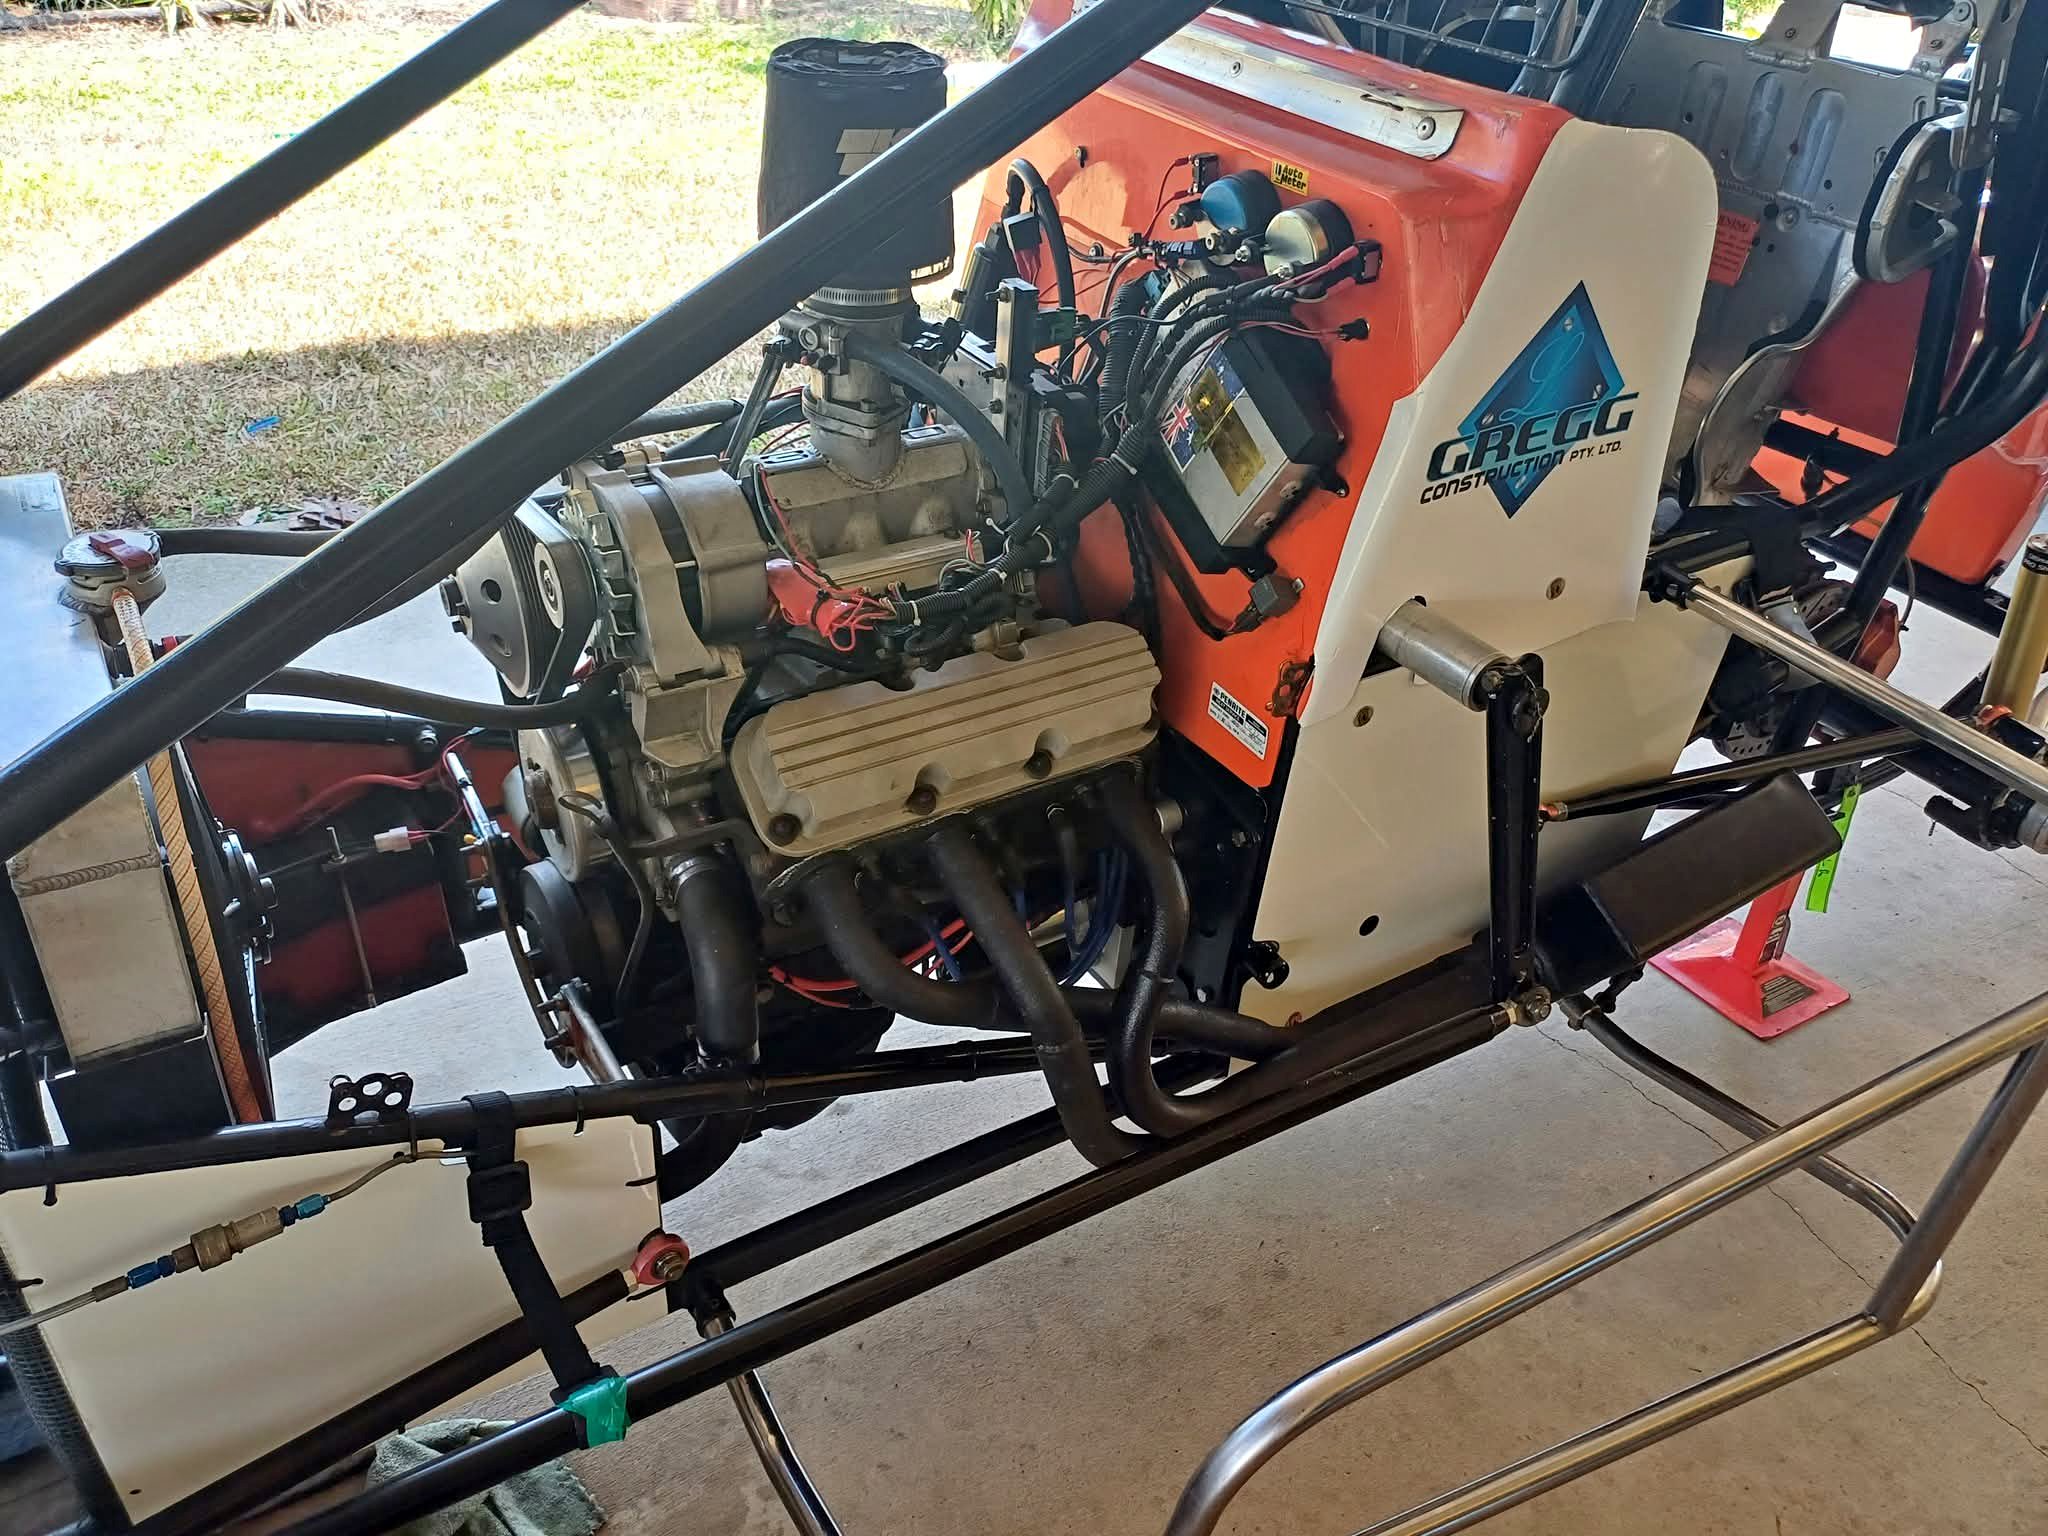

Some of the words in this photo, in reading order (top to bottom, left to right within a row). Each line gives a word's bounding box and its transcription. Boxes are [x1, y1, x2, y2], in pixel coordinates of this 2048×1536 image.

[1280, 174, 1306, 190] Meter
[1283, 165, 1304, 180] Auto
[1426, 391, 1640, 483] GREGG
[1419, 449, 1567, 505] CONSTRUCTION
[1568, 448, 1596, 463] PTY.
[1597, 439, 1623, 456] LTD.
[1220, 691, 1246, 719] PENRITE
